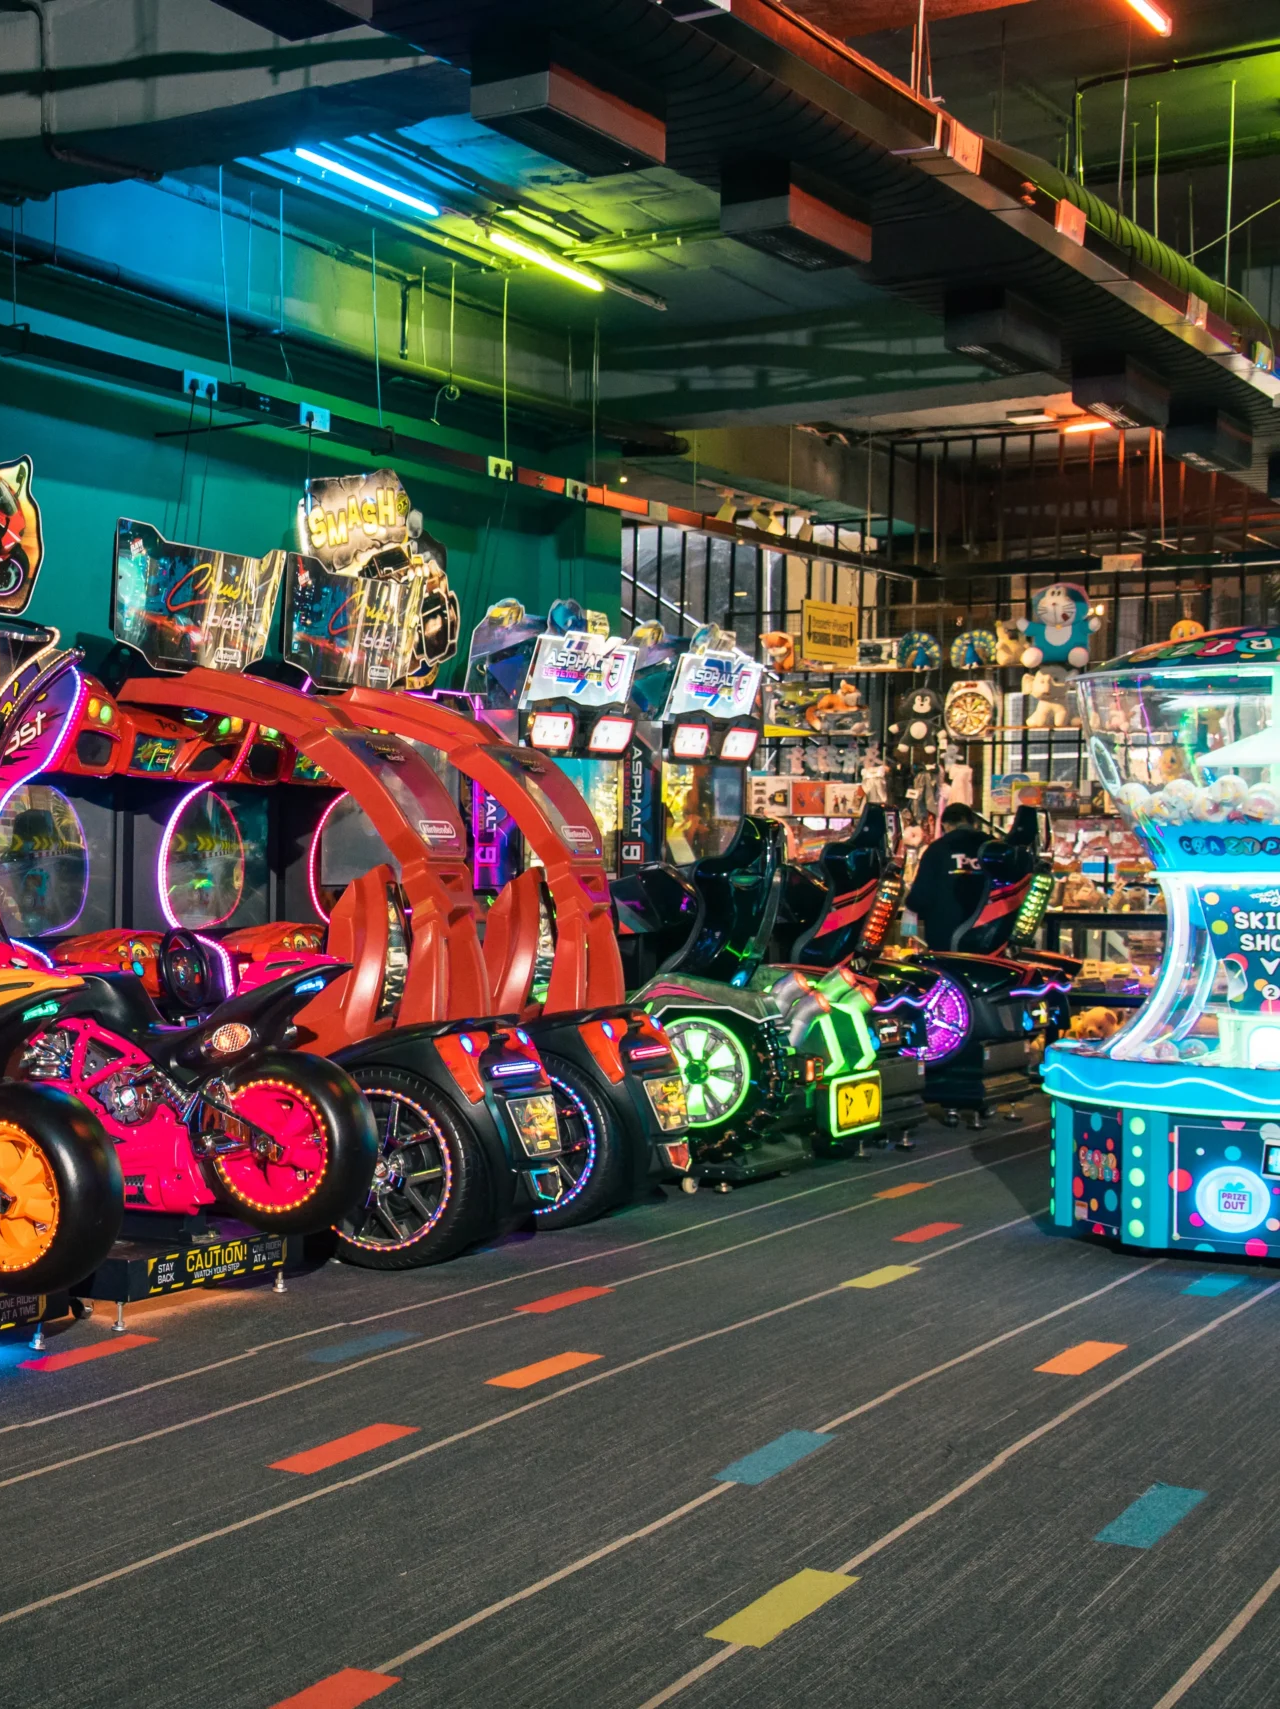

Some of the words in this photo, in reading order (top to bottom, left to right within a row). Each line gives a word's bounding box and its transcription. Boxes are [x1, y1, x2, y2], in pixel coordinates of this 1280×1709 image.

[308, 487, 396, 548] SMASH
[631, 746, 642, 837] ASPHALT
[1180, 837, 1260, 855] CRAZY
[1234, 911, 1280, 931] SKI
[1221, 1192, 1247, 1201] PRIZE
[1223, 1200, 1246, 1211] OUT
[186, 1243, 248, 1273] CAUTION!
[158, 1262, 174, 1274] STAY
[193, 1268, 213, 1279] WATCH
[213, 1264, 228, 1275] YOUR
[227, 1262, 240, 1272] STEP
[157, 1272, 175, 1284] BACK
[0, 1298, 15, 1311] ONE
